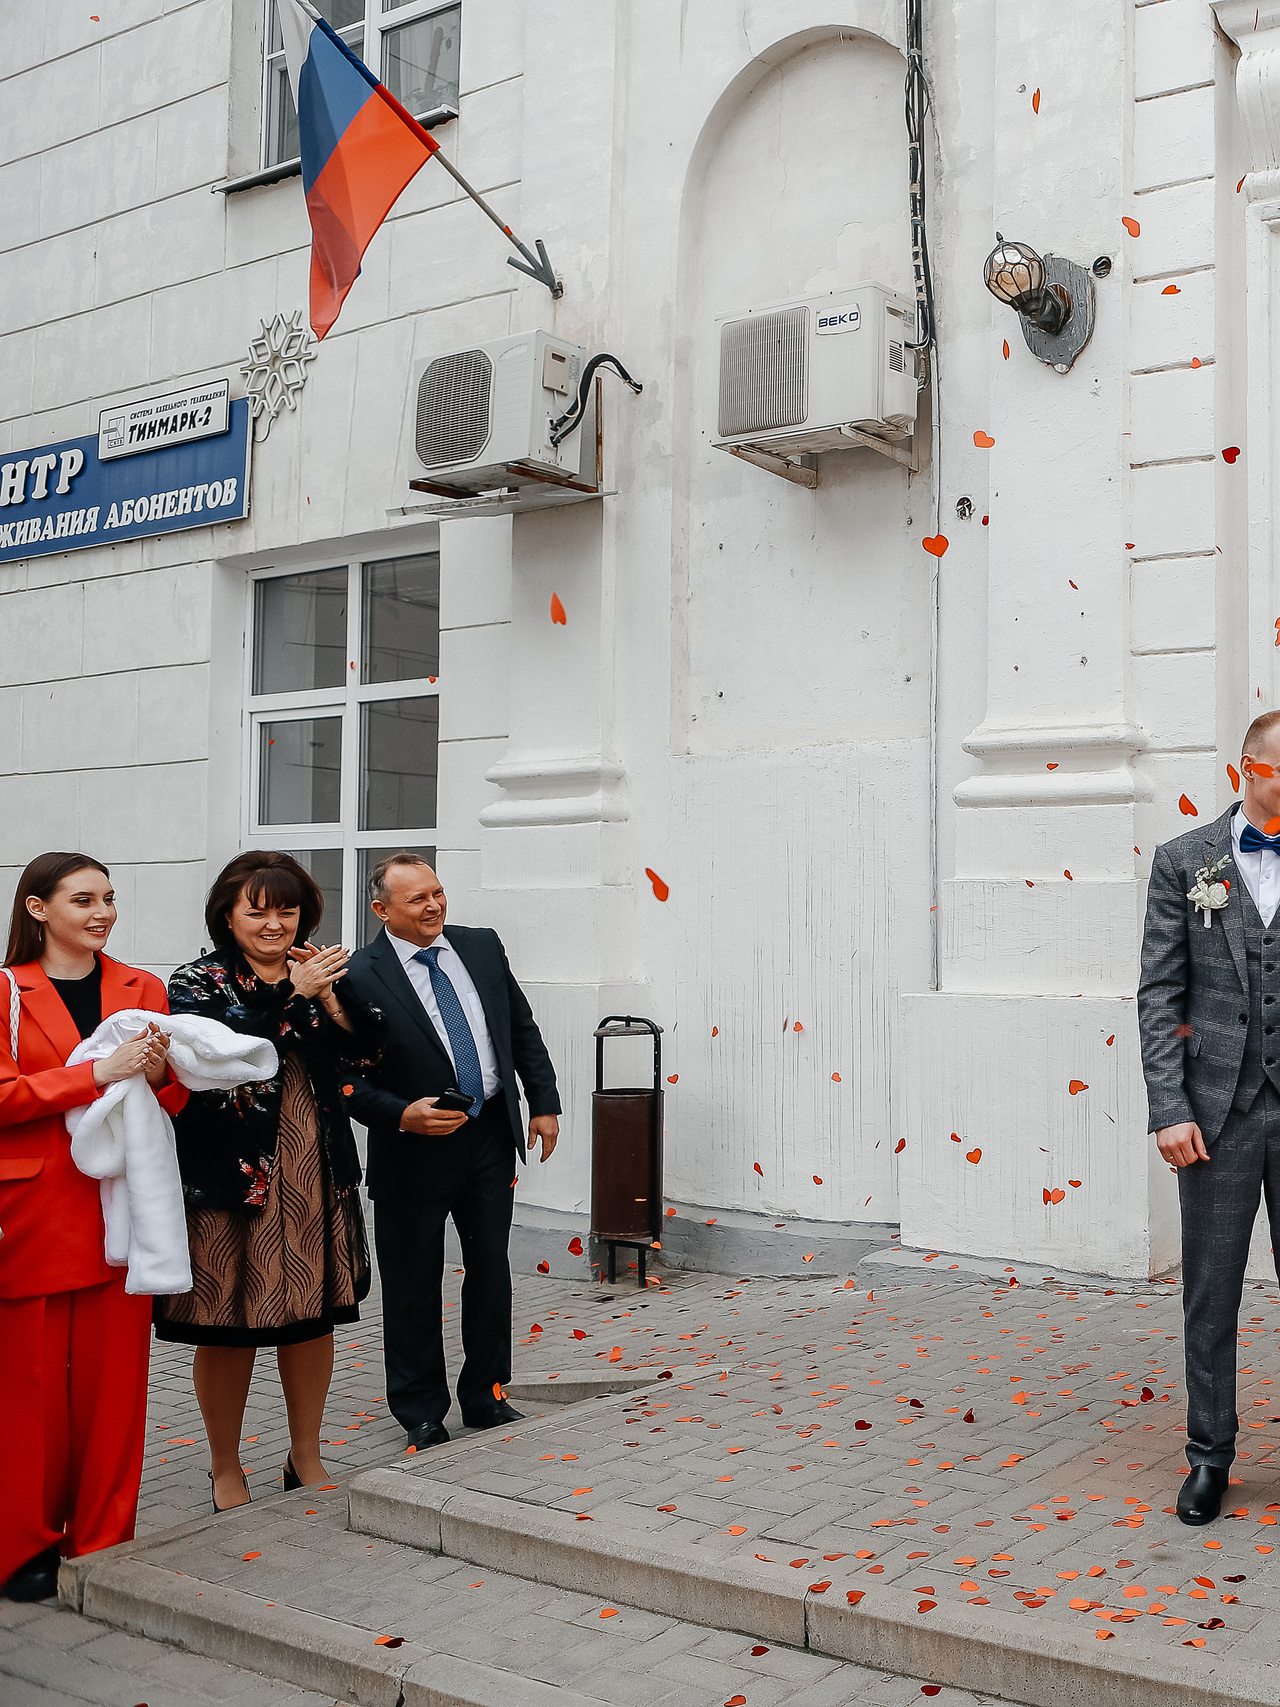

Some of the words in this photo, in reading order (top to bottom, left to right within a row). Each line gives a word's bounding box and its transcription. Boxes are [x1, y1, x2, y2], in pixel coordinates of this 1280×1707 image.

[818, 311, 859, 328] BEKO
[128, 405, 213, 445] ТИНМАРК-2
[129, 407, 153, 420] СИСТЕМА
[103, 477, 238, 530] АБОНЕНТОВ
